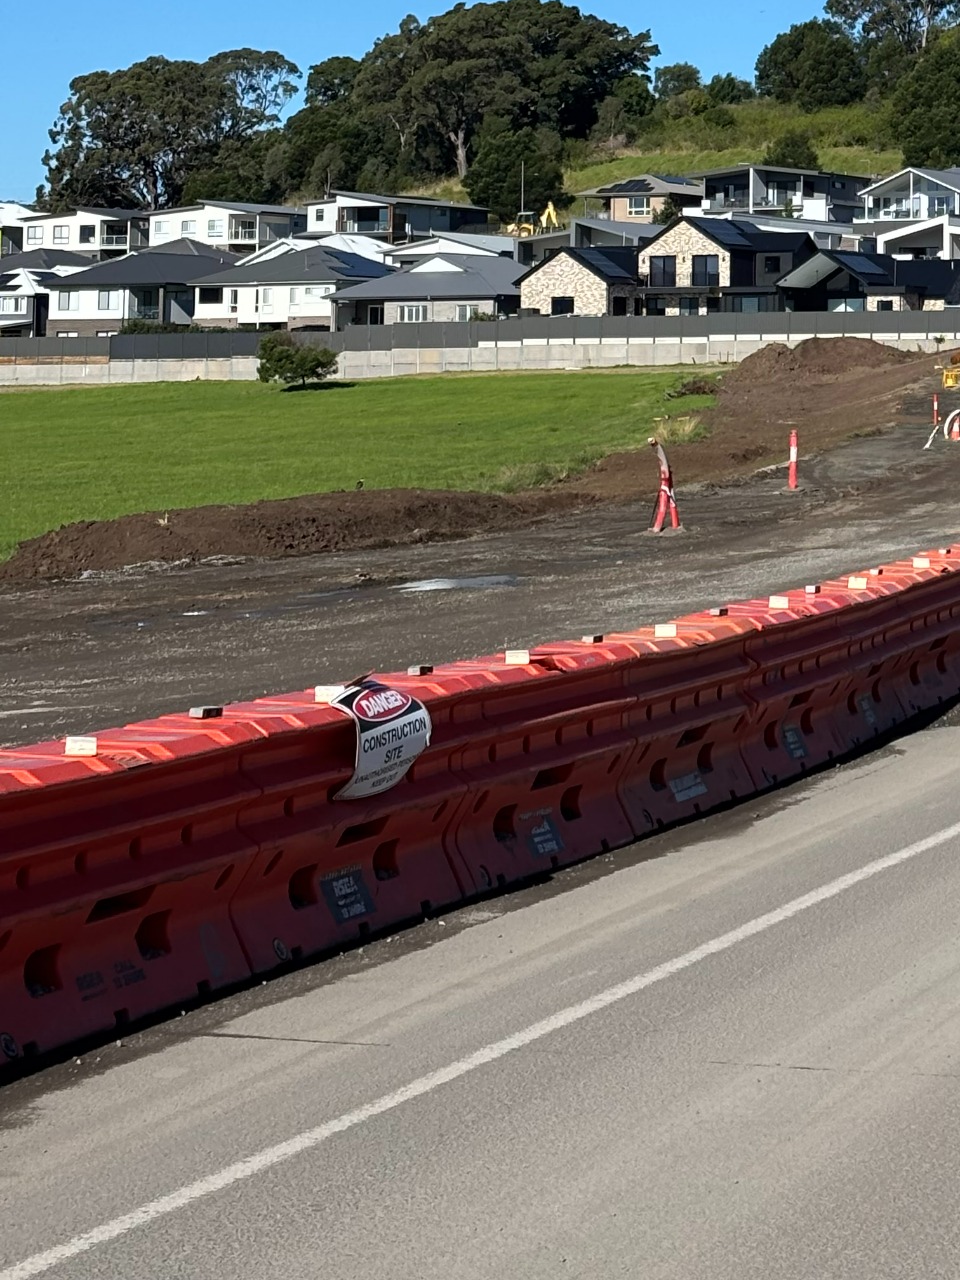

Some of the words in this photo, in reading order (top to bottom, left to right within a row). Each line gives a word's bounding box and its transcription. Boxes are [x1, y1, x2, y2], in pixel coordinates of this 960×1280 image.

[359, 690, 407, 717] DANGER
[362, 717, 427, 754] CONSTRUCTION
[384, 744, 404, 765] SITE
